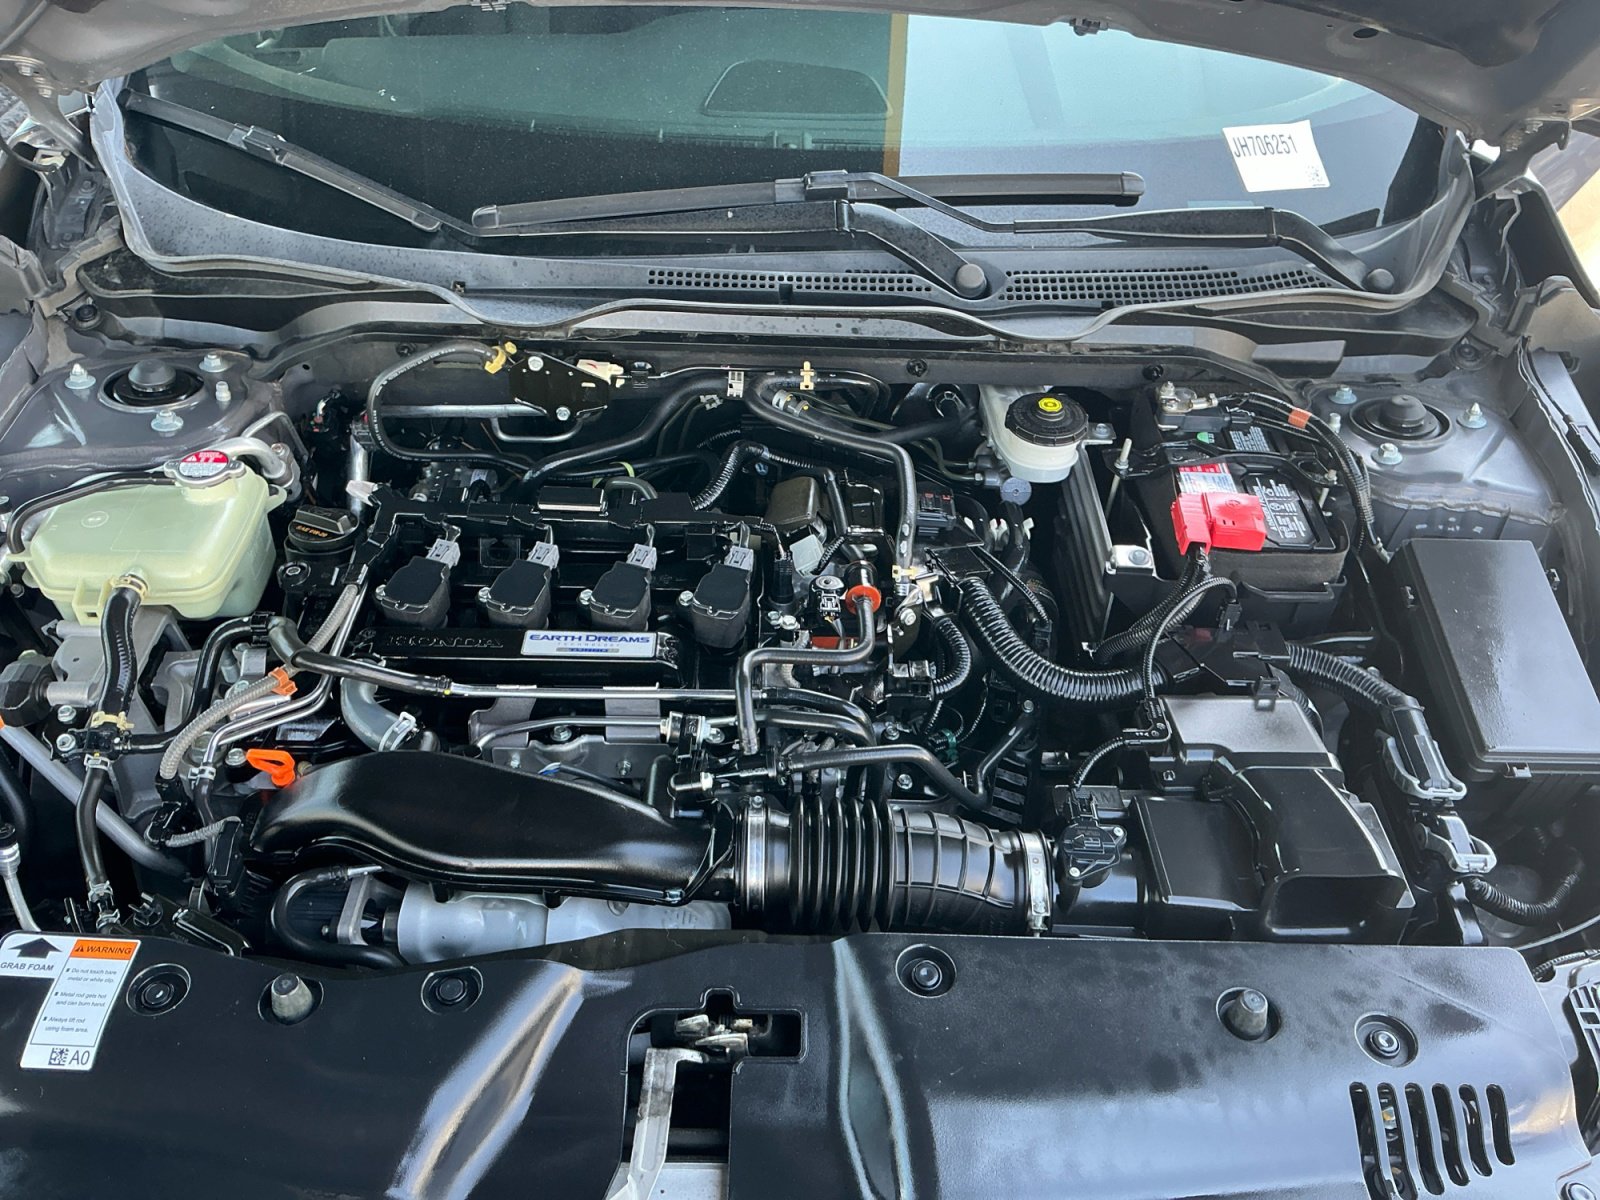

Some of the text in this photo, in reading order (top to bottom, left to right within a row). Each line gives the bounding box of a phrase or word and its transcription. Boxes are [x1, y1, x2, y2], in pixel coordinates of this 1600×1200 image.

[1232, 134, 1298, 158] JH706251
[529, 634, 650, 644] EARTH DREAMS
[86, 945, 132, 955] WARNING
[0, 961, 54, 971] GRAB FOAM
[68, 1050, 91, 1066] A0
